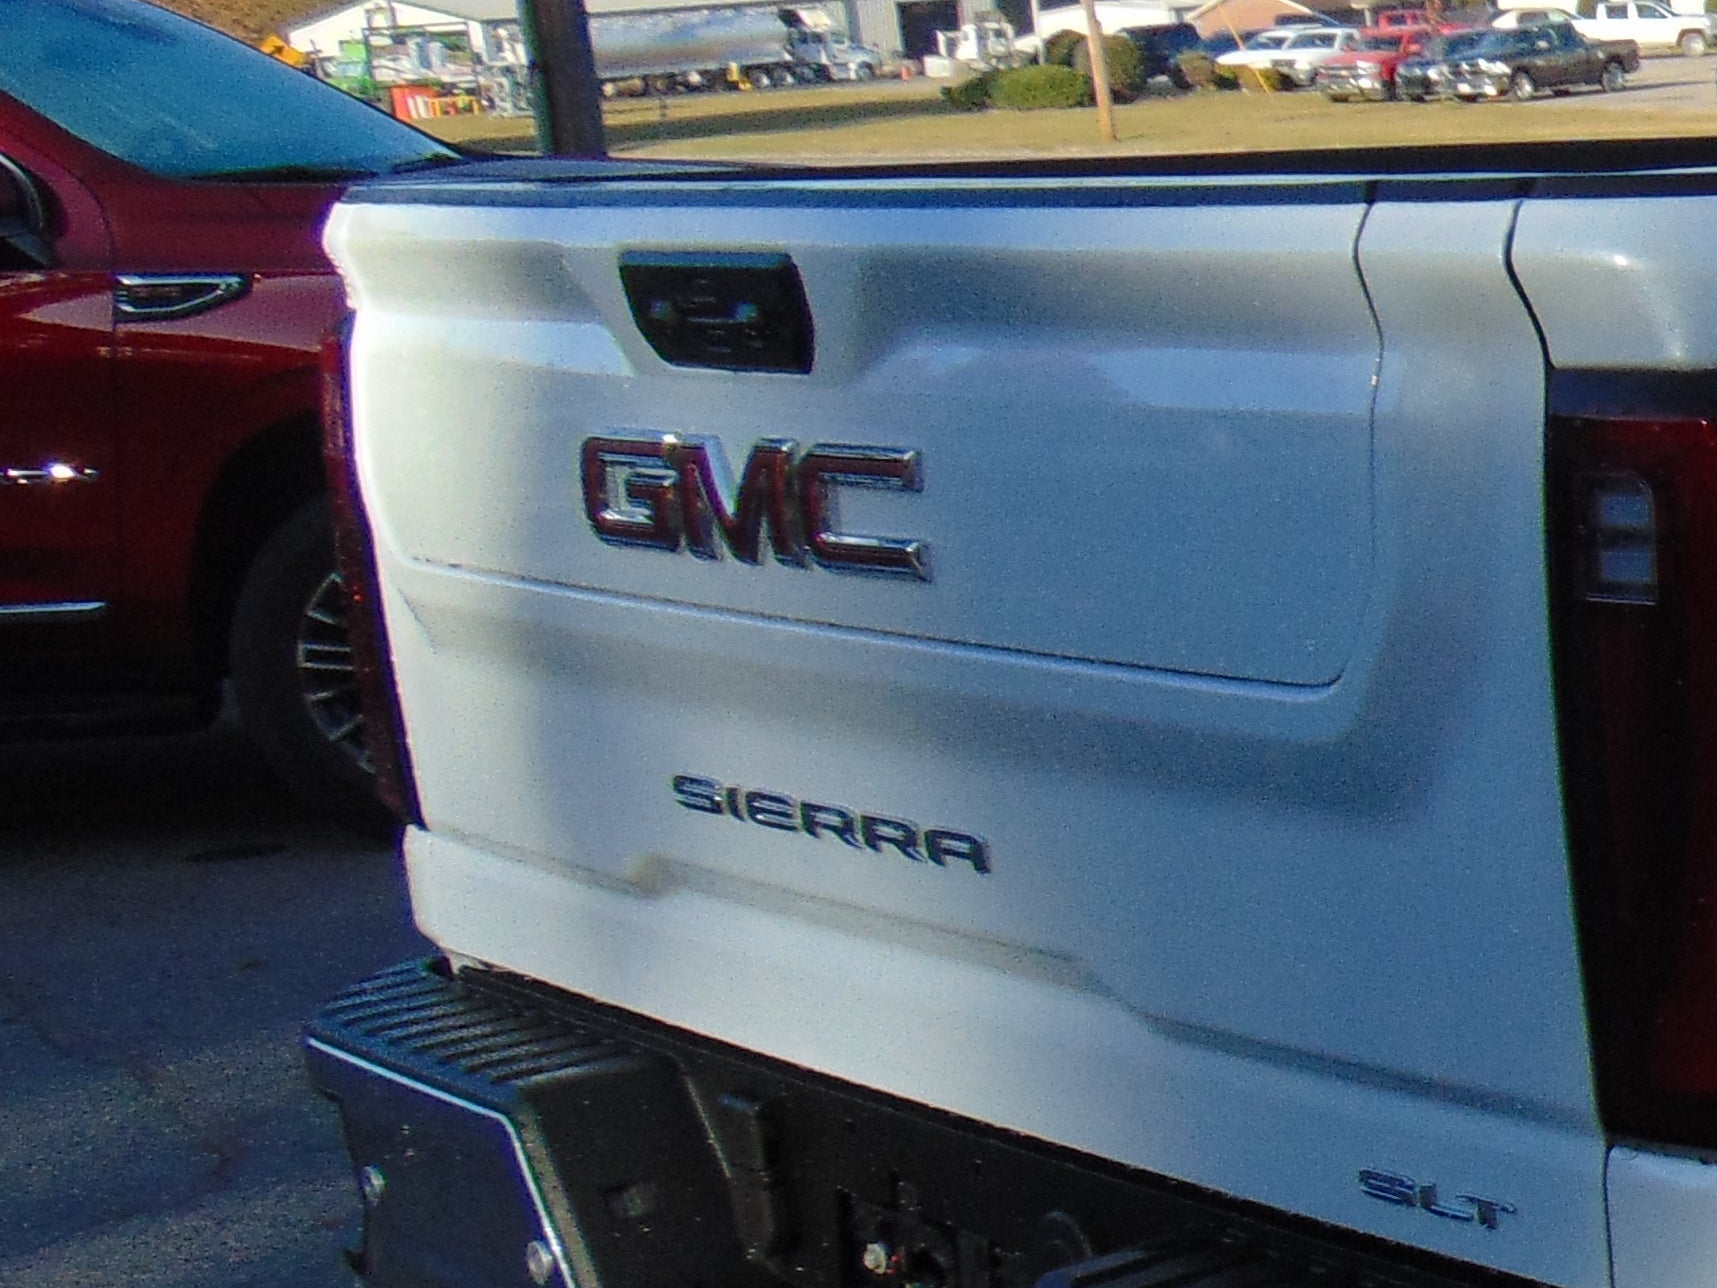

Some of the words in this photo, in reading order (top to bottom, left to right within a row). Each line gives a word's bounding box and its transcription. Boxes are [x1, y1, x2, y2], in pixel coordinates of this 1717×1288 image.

[581, 427, 932, 582] GMC
[672, 772, 992, 875] SIERRA
[1358, 1167, 1517, 1231] SLT
